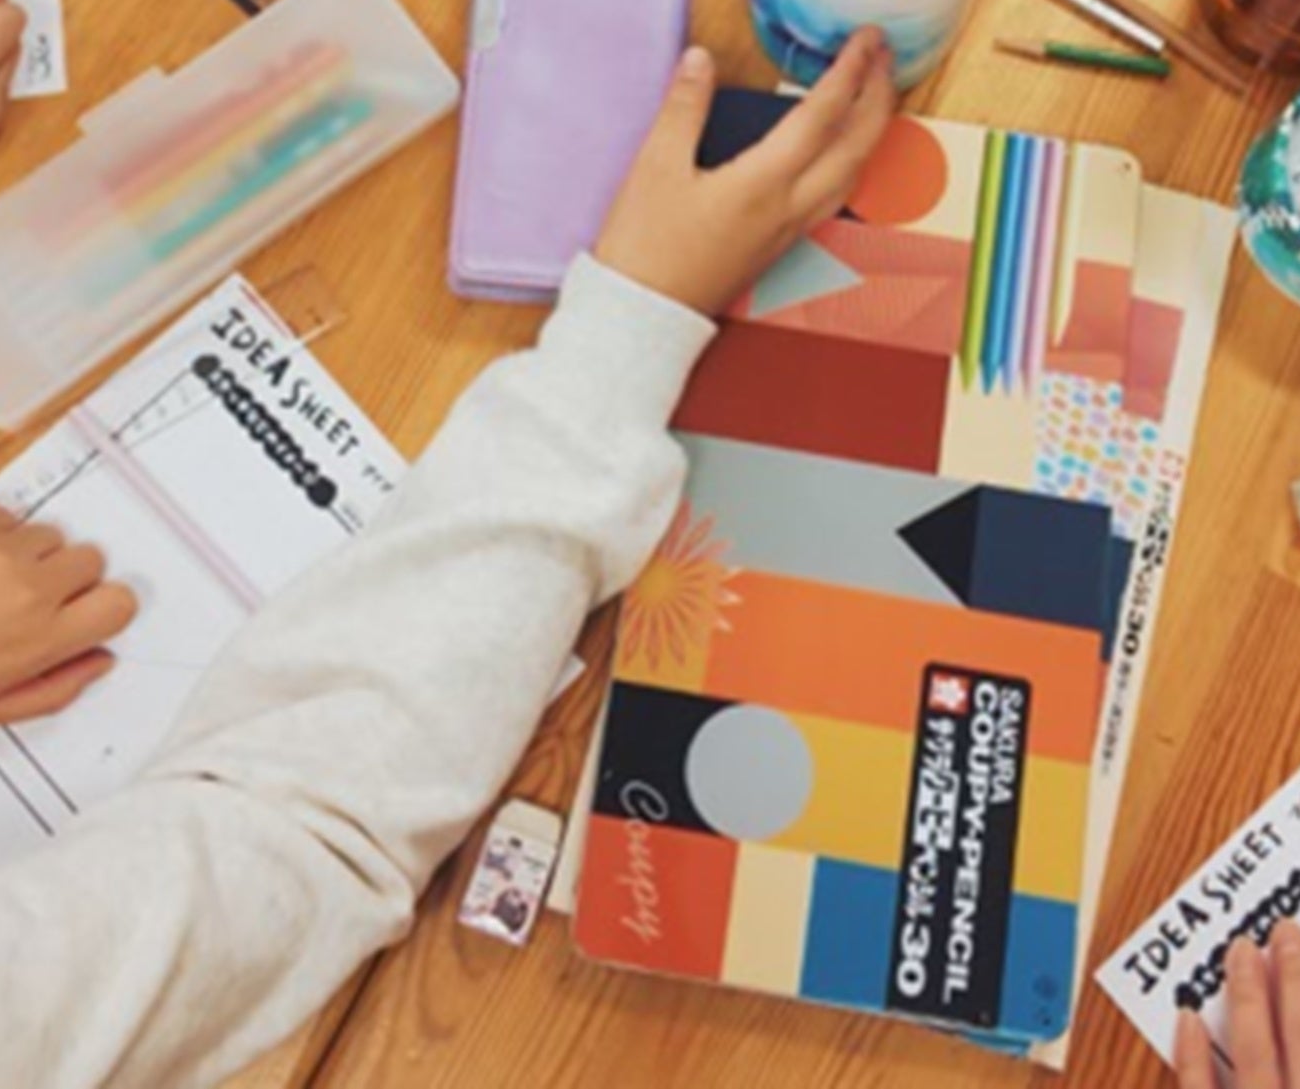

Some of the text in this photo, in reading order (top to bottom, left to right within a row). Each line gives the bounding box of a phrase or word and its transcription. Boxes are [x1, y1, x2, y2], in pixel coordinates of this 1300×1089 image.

[209, 306, 291, 388] IDEA
[278, 378, 360, 457] SHEET
[1121, 609, 1146, 656] 30
[988, 686, 1023, 804] SAKURA
[614, 780, 670, 945] Coupy
[941, 681, 999, 1005] COUPY-PENCIL
[1122, 898, 1211, 996] IDEA
[1200, 821, 1285, 914] SHEET
